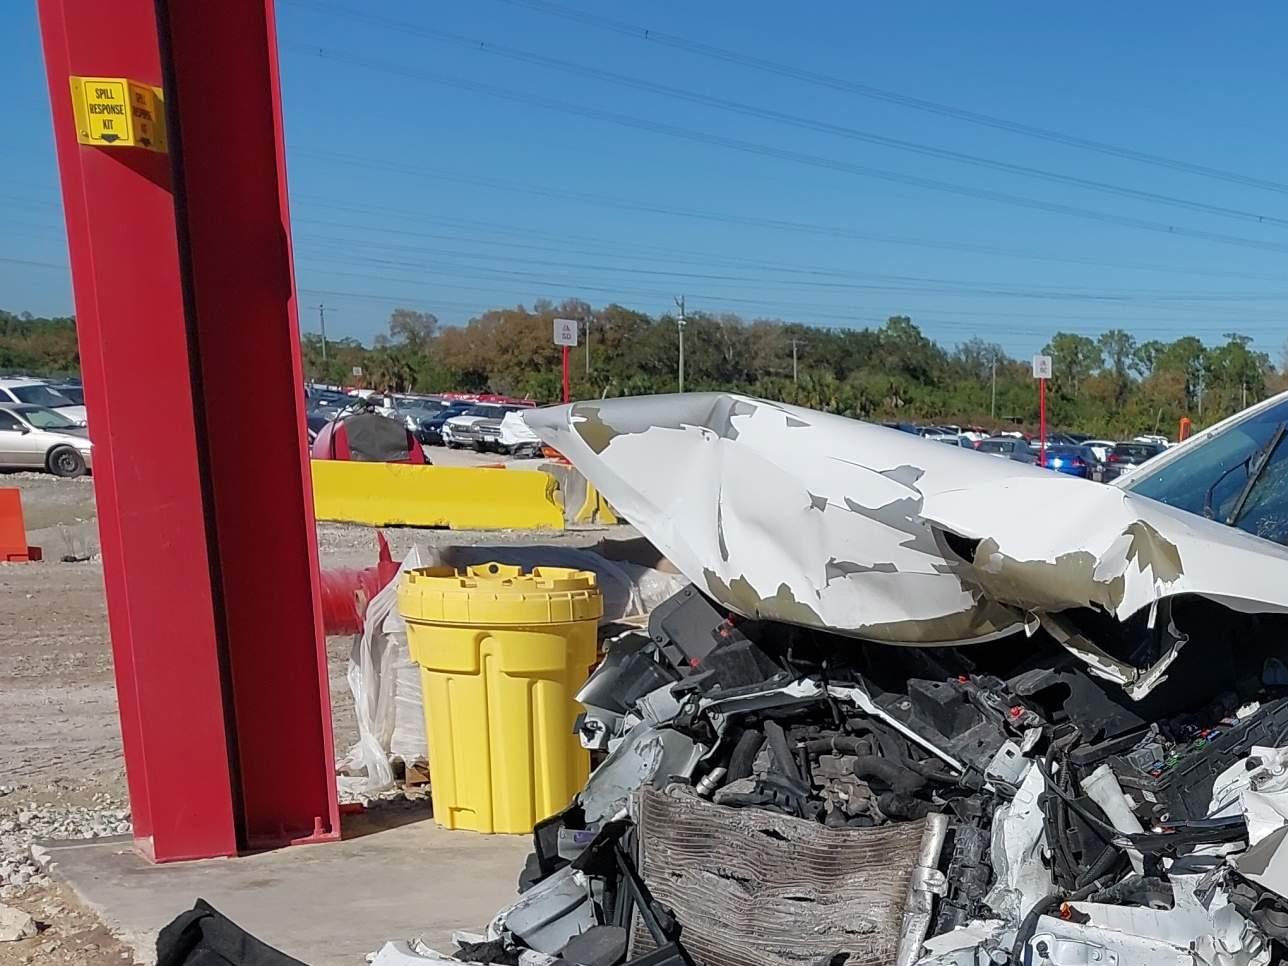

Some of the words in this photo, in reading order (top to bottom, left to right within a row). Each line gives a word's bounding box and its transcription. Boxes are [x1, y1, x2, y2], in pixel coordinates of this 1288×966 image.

[95, 88, 114, 99] SPILL
[89, 103, 124, 115] RESPONSE
[102, 119, 113, 130] KIT
